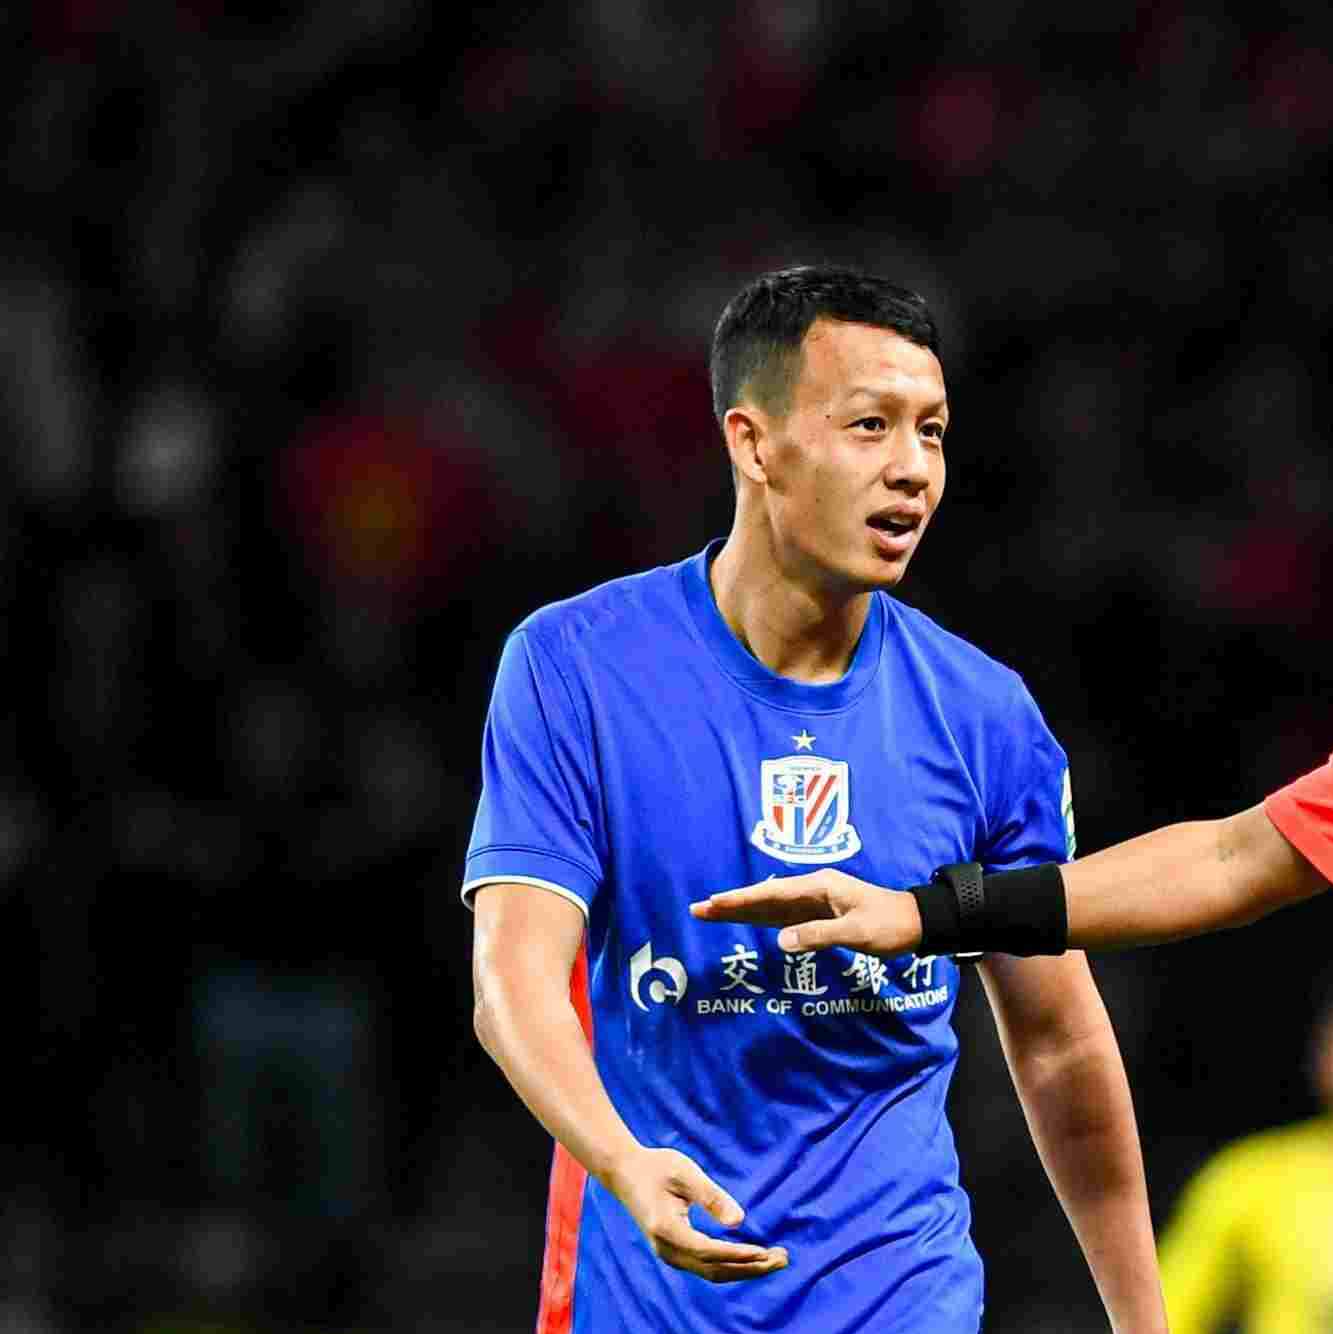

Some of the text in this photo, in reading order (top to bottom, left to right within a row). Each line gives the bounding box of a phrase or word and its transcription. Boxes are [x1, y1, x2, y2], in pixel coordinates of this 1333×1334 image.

[697, 986, 949, 1017] BANK OF COMMUNICATIONS
